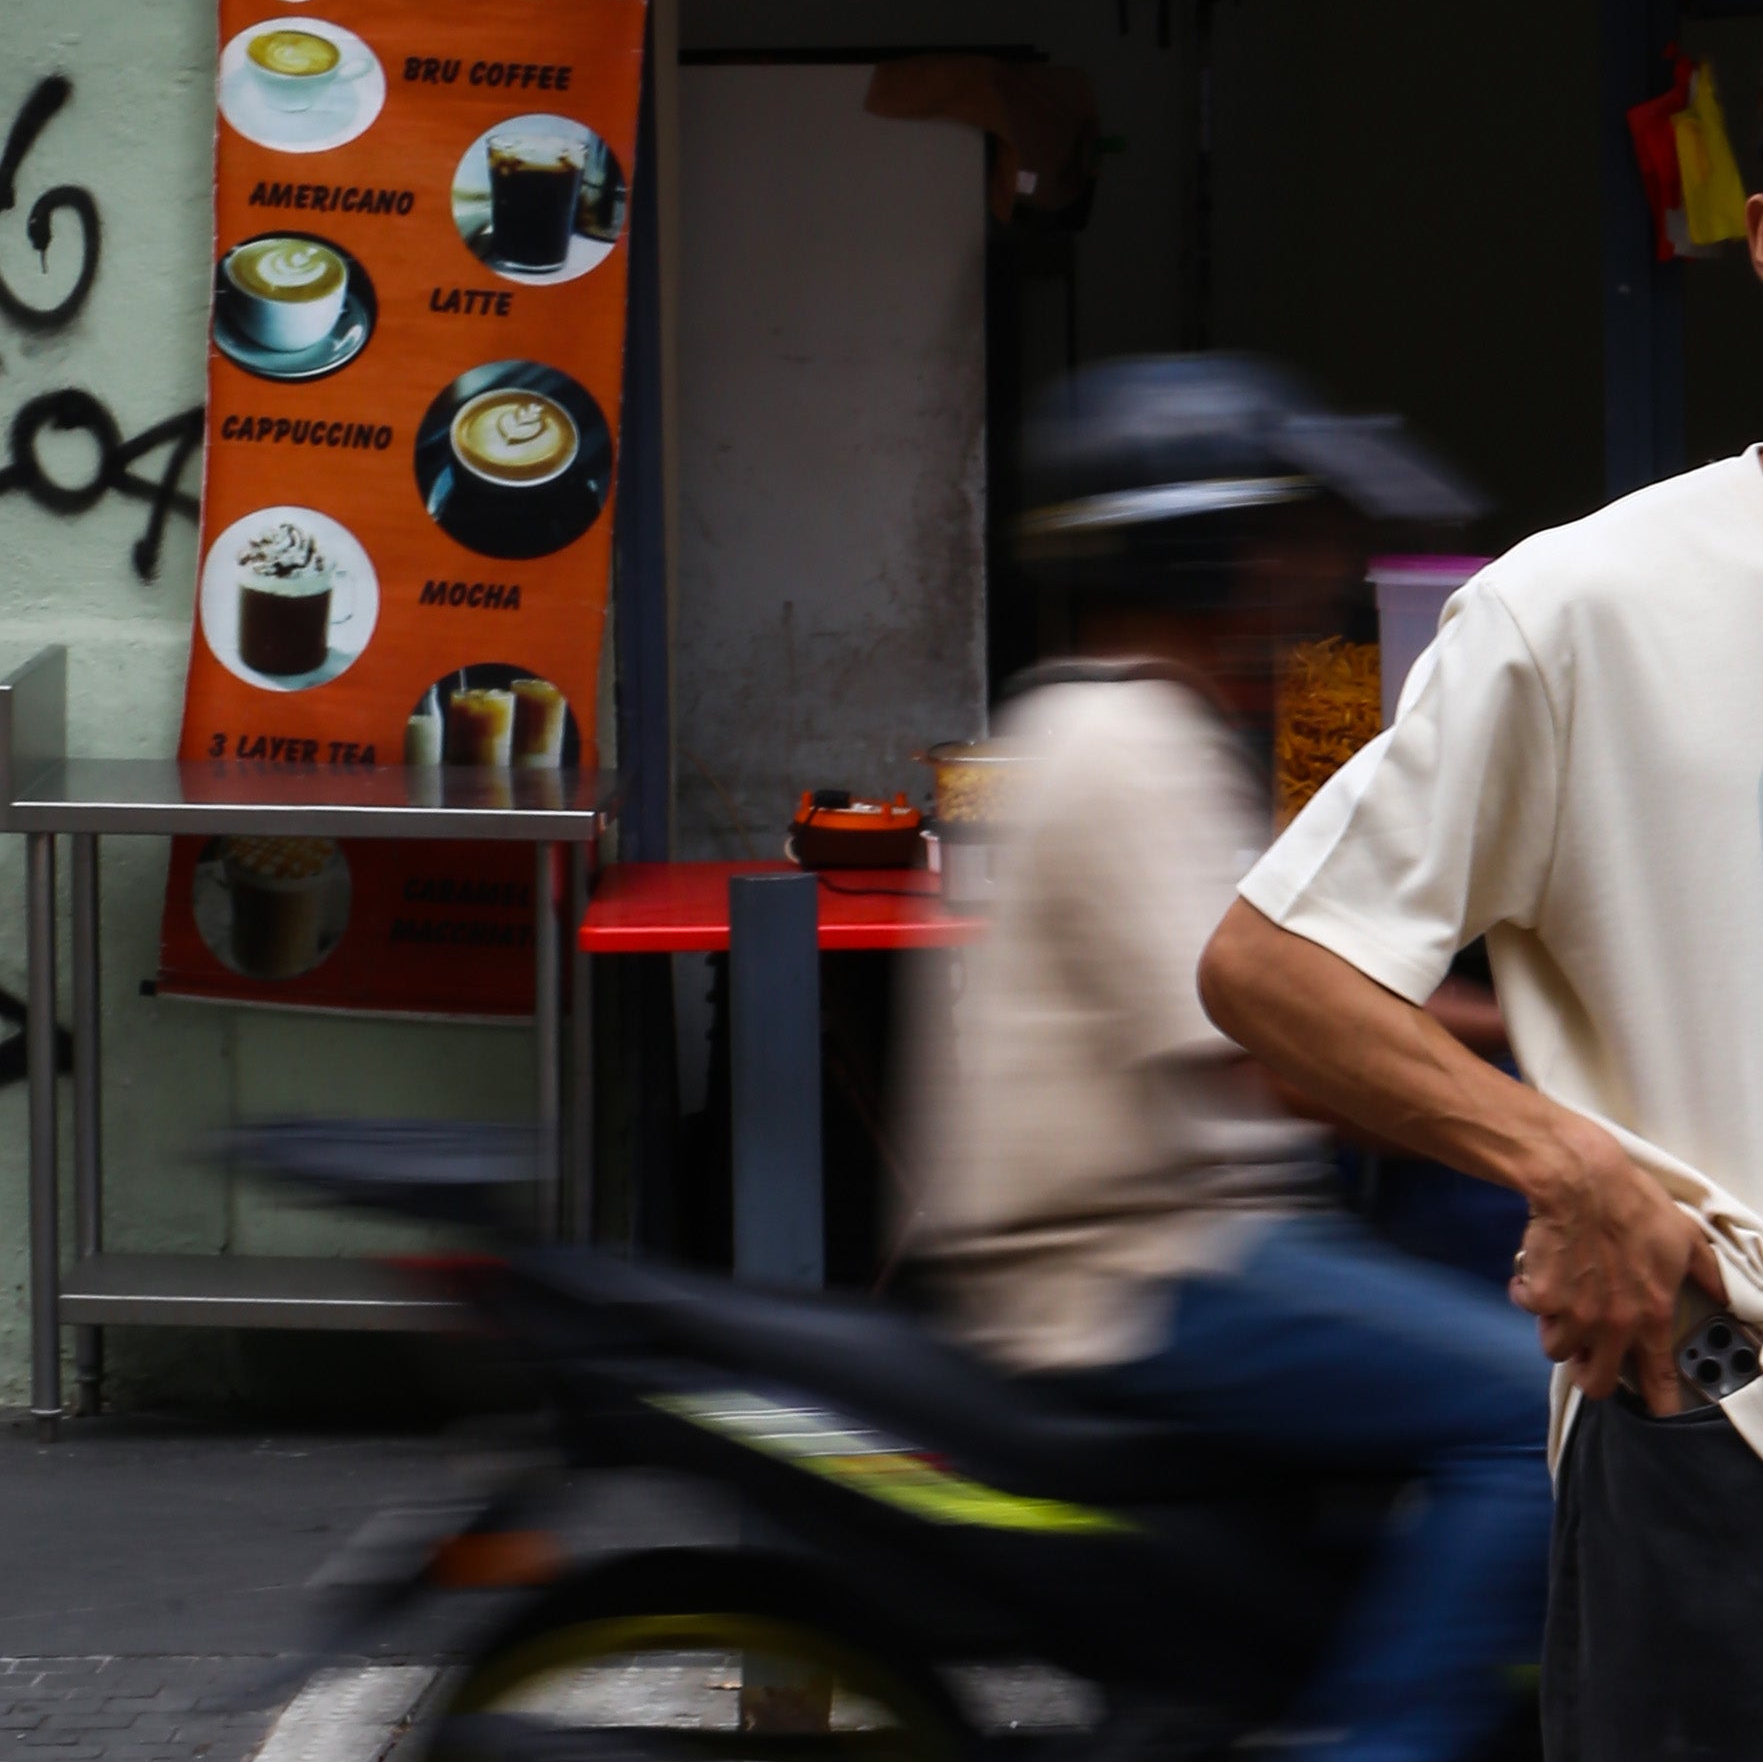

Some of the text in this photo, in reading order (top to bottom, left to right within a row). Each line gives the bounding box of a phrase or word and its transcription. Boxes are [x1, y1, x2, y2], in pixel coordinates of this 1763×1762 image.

[404, 56, 572, 90] BRU COFFEE
[249, 182, 414, 216] AMERICANO
[430, 288, 513, 317] LATTE
[221, 415, 393, 450] CAPPUCCINO
[419, 580, 521, 610] MOCHA
[209, 733, 376, 764] 3 LAYER TEA
[390, 917, 537, 948] MACCHIAT
